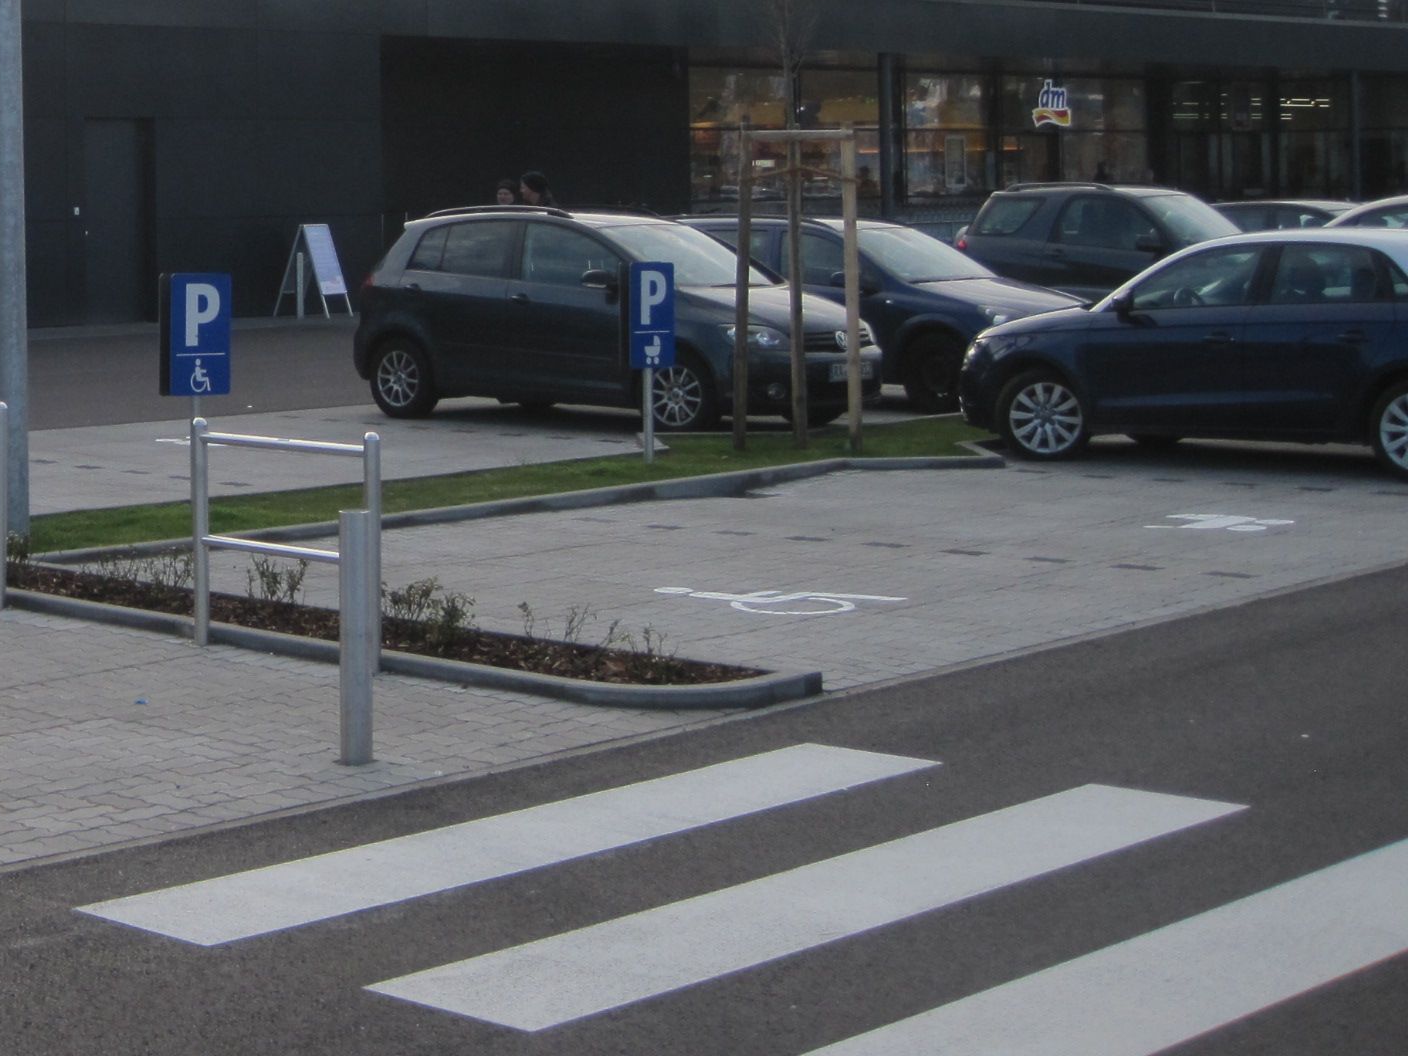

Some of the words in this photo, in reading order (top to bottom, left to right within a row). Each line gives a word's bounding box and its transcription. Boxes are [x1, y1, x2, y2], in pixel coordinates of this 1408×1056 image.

[1040, 81, 1066, 108] dm
[185, 283, 220, 347] P
[640, 270, 666, 326] P
